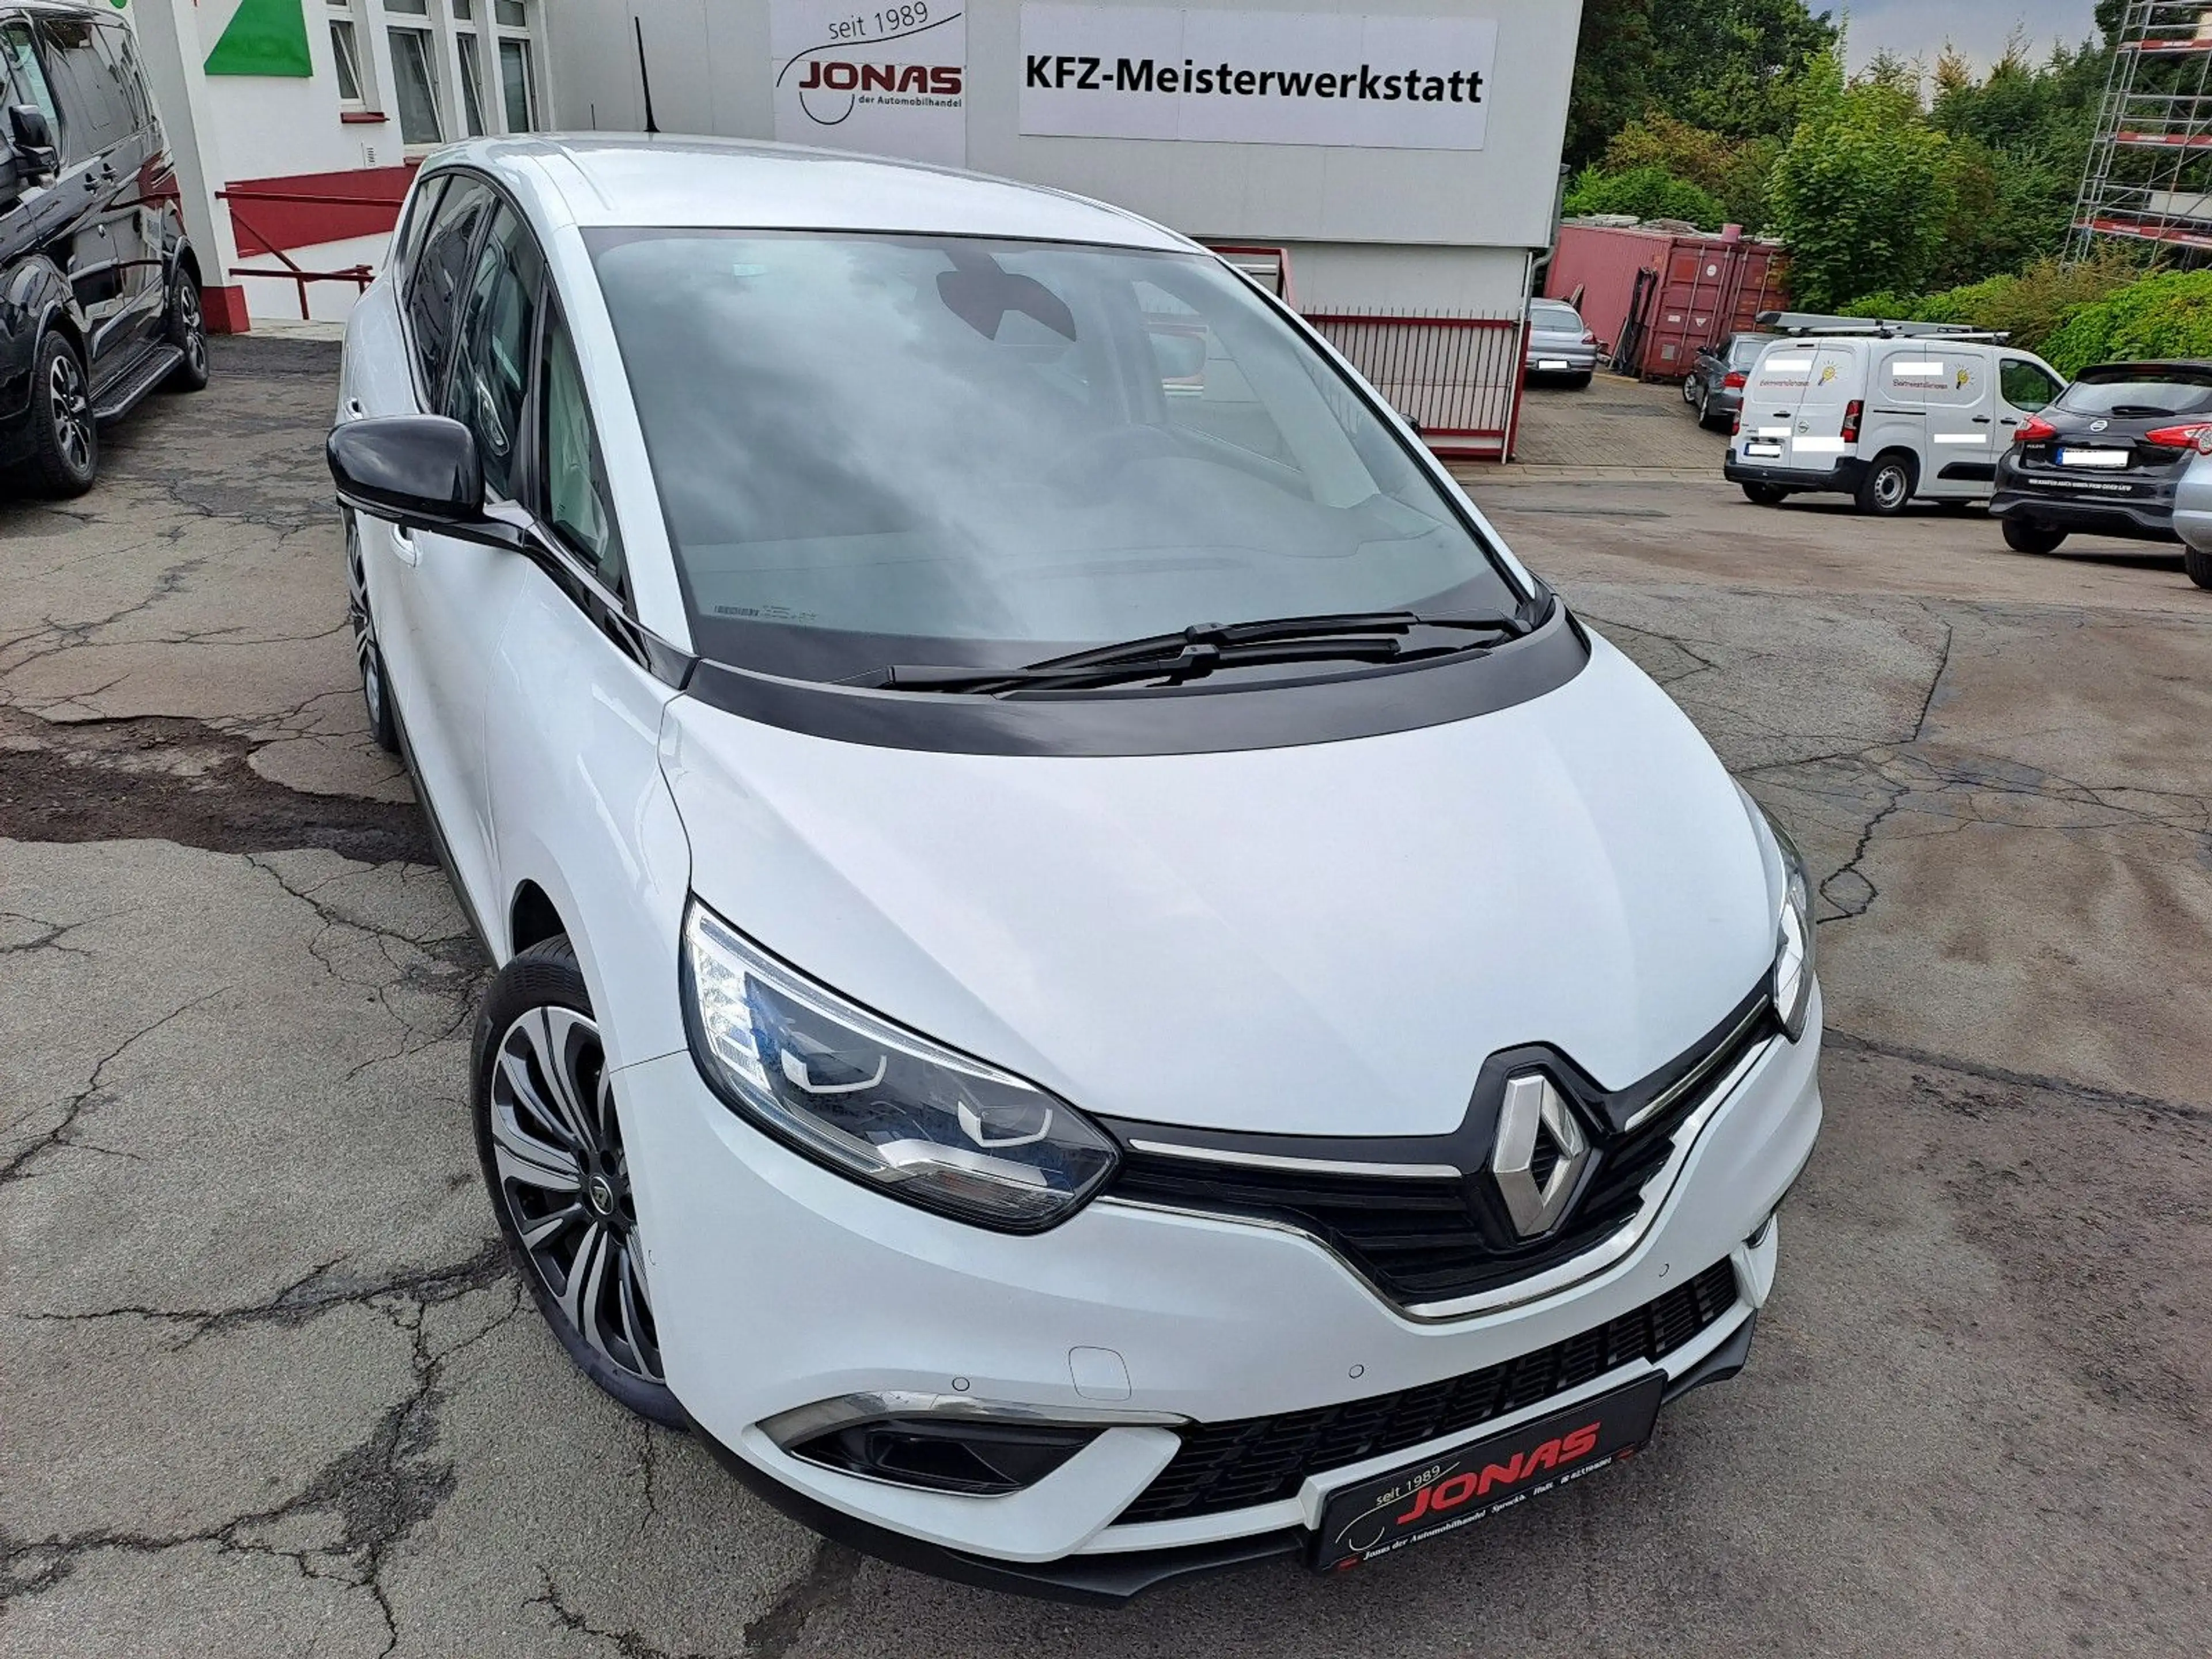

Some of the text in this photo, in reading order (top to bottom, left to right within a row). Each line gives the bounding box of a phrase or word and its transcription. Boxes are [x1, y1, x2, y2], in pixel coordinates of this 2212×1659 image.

[829, 1, 928, 39] seit 1989
[799, 60, 961, 94] JONAS
[1027, 54, 1484, 103] KFZ-Meisterwerkstatt
[858, 95, 962, 108] der Automobilhandel
[1376, 1465, 1441, 1506] seit 1989
[1396, 1421, 1601, 1525] JONAS
[1392, 1538, 1408, 1550] der
